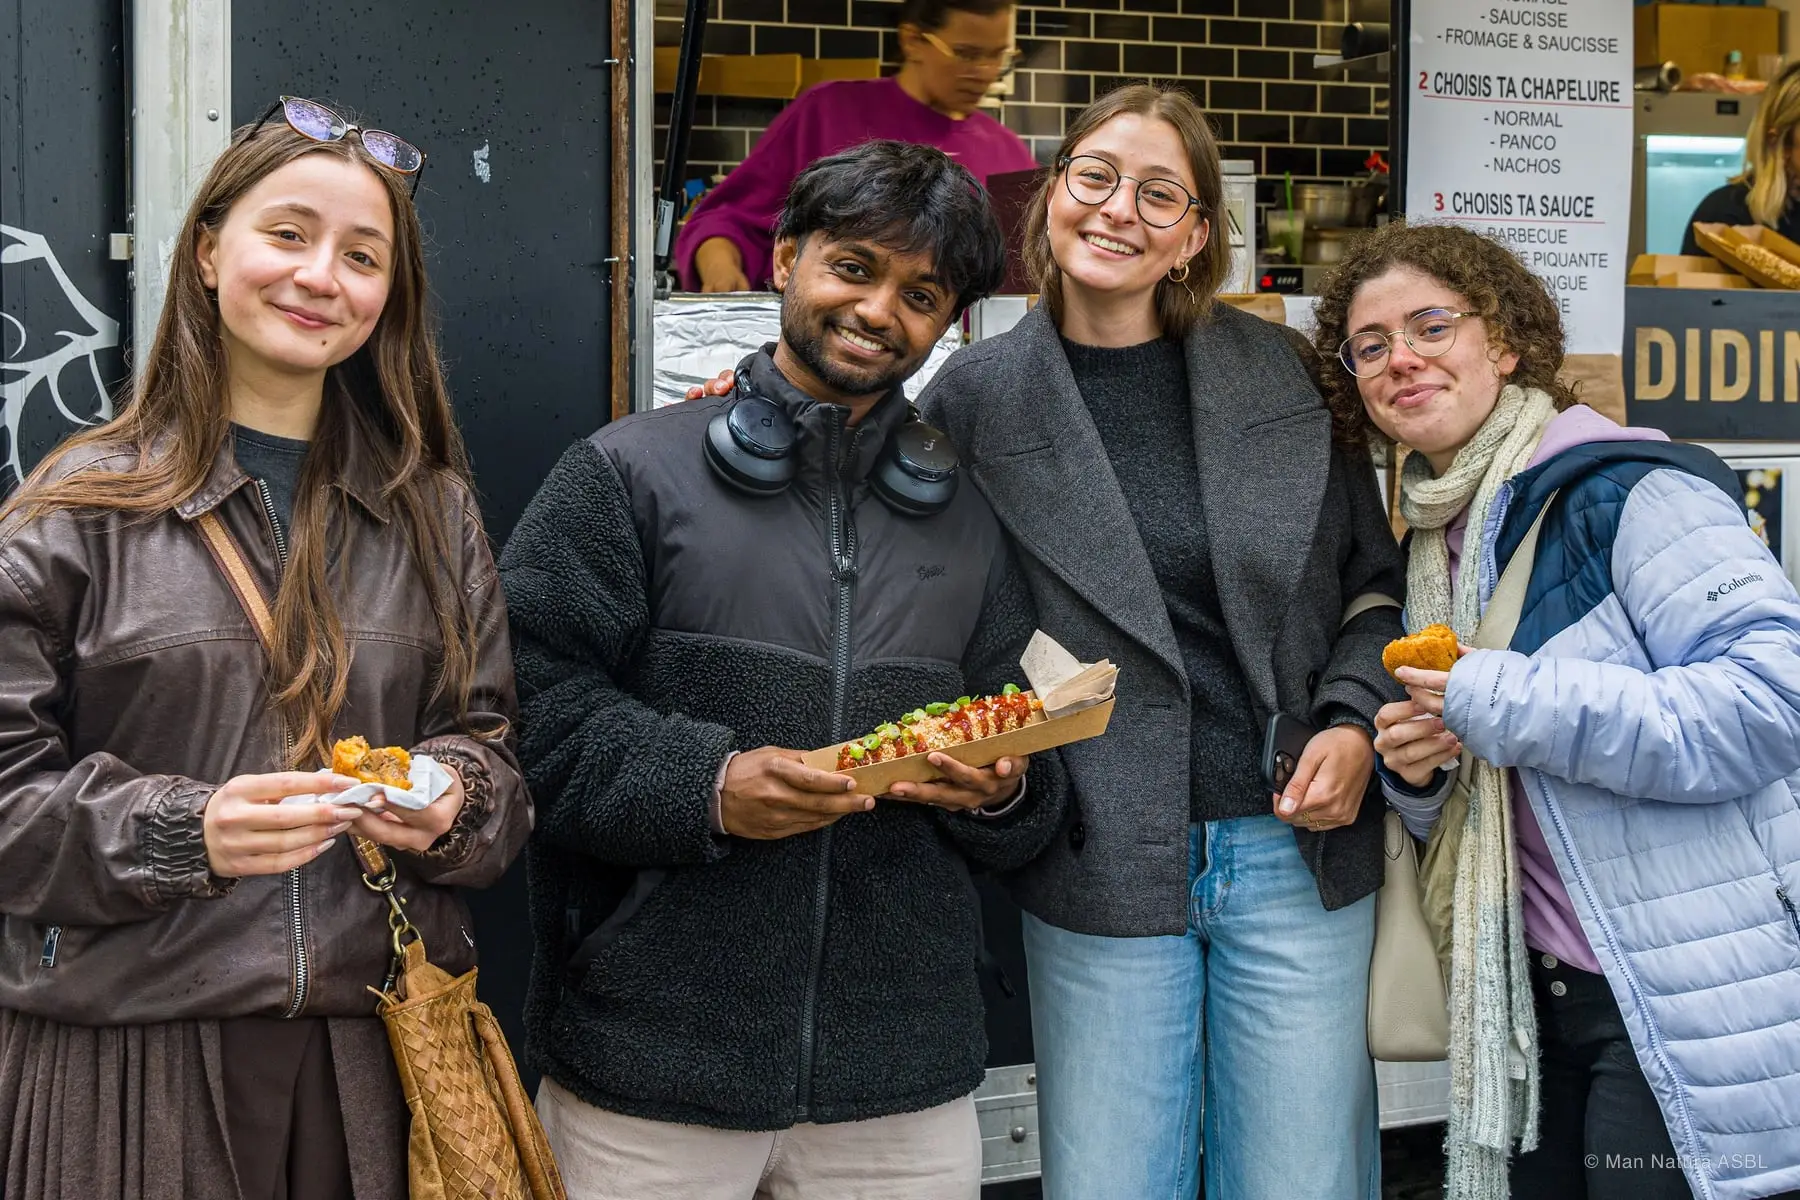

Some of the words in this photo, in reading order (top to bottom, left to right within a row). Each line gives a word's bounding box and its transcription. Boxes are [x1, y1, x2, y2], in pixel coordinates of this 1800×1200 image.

[1489, 9, 1568, 28] SAUCISSE
[1445, 28, 1518, 49] FROMAGE
[1523, 35, 1533, 50] &
[1538, 35, 1619, 53] SAUCISSE
[1418, 71, 1428, 90] 2
[1434, 72, 1492, 98] CHOISIS
[1497, 76, 1518, 99] TA
[1521, 77, 1620, 102] CHAPELURE
[1494, 110, 1563, 128] NORMAL
[1500, 134, 1556, 150] PANCO
[1493, 157, 1561, 174] NACHOS
[1434, 193, 1445, 211] 3
[1452, 192, 1513, 216] CHOISIS
[1517, 195, 1536, 216] TA
[1540, 195, 1594, 217] SAUCE
[1533, 251, 1608, 268] PIQUANTE
[1718, 572, 1764, 595] Columbia
